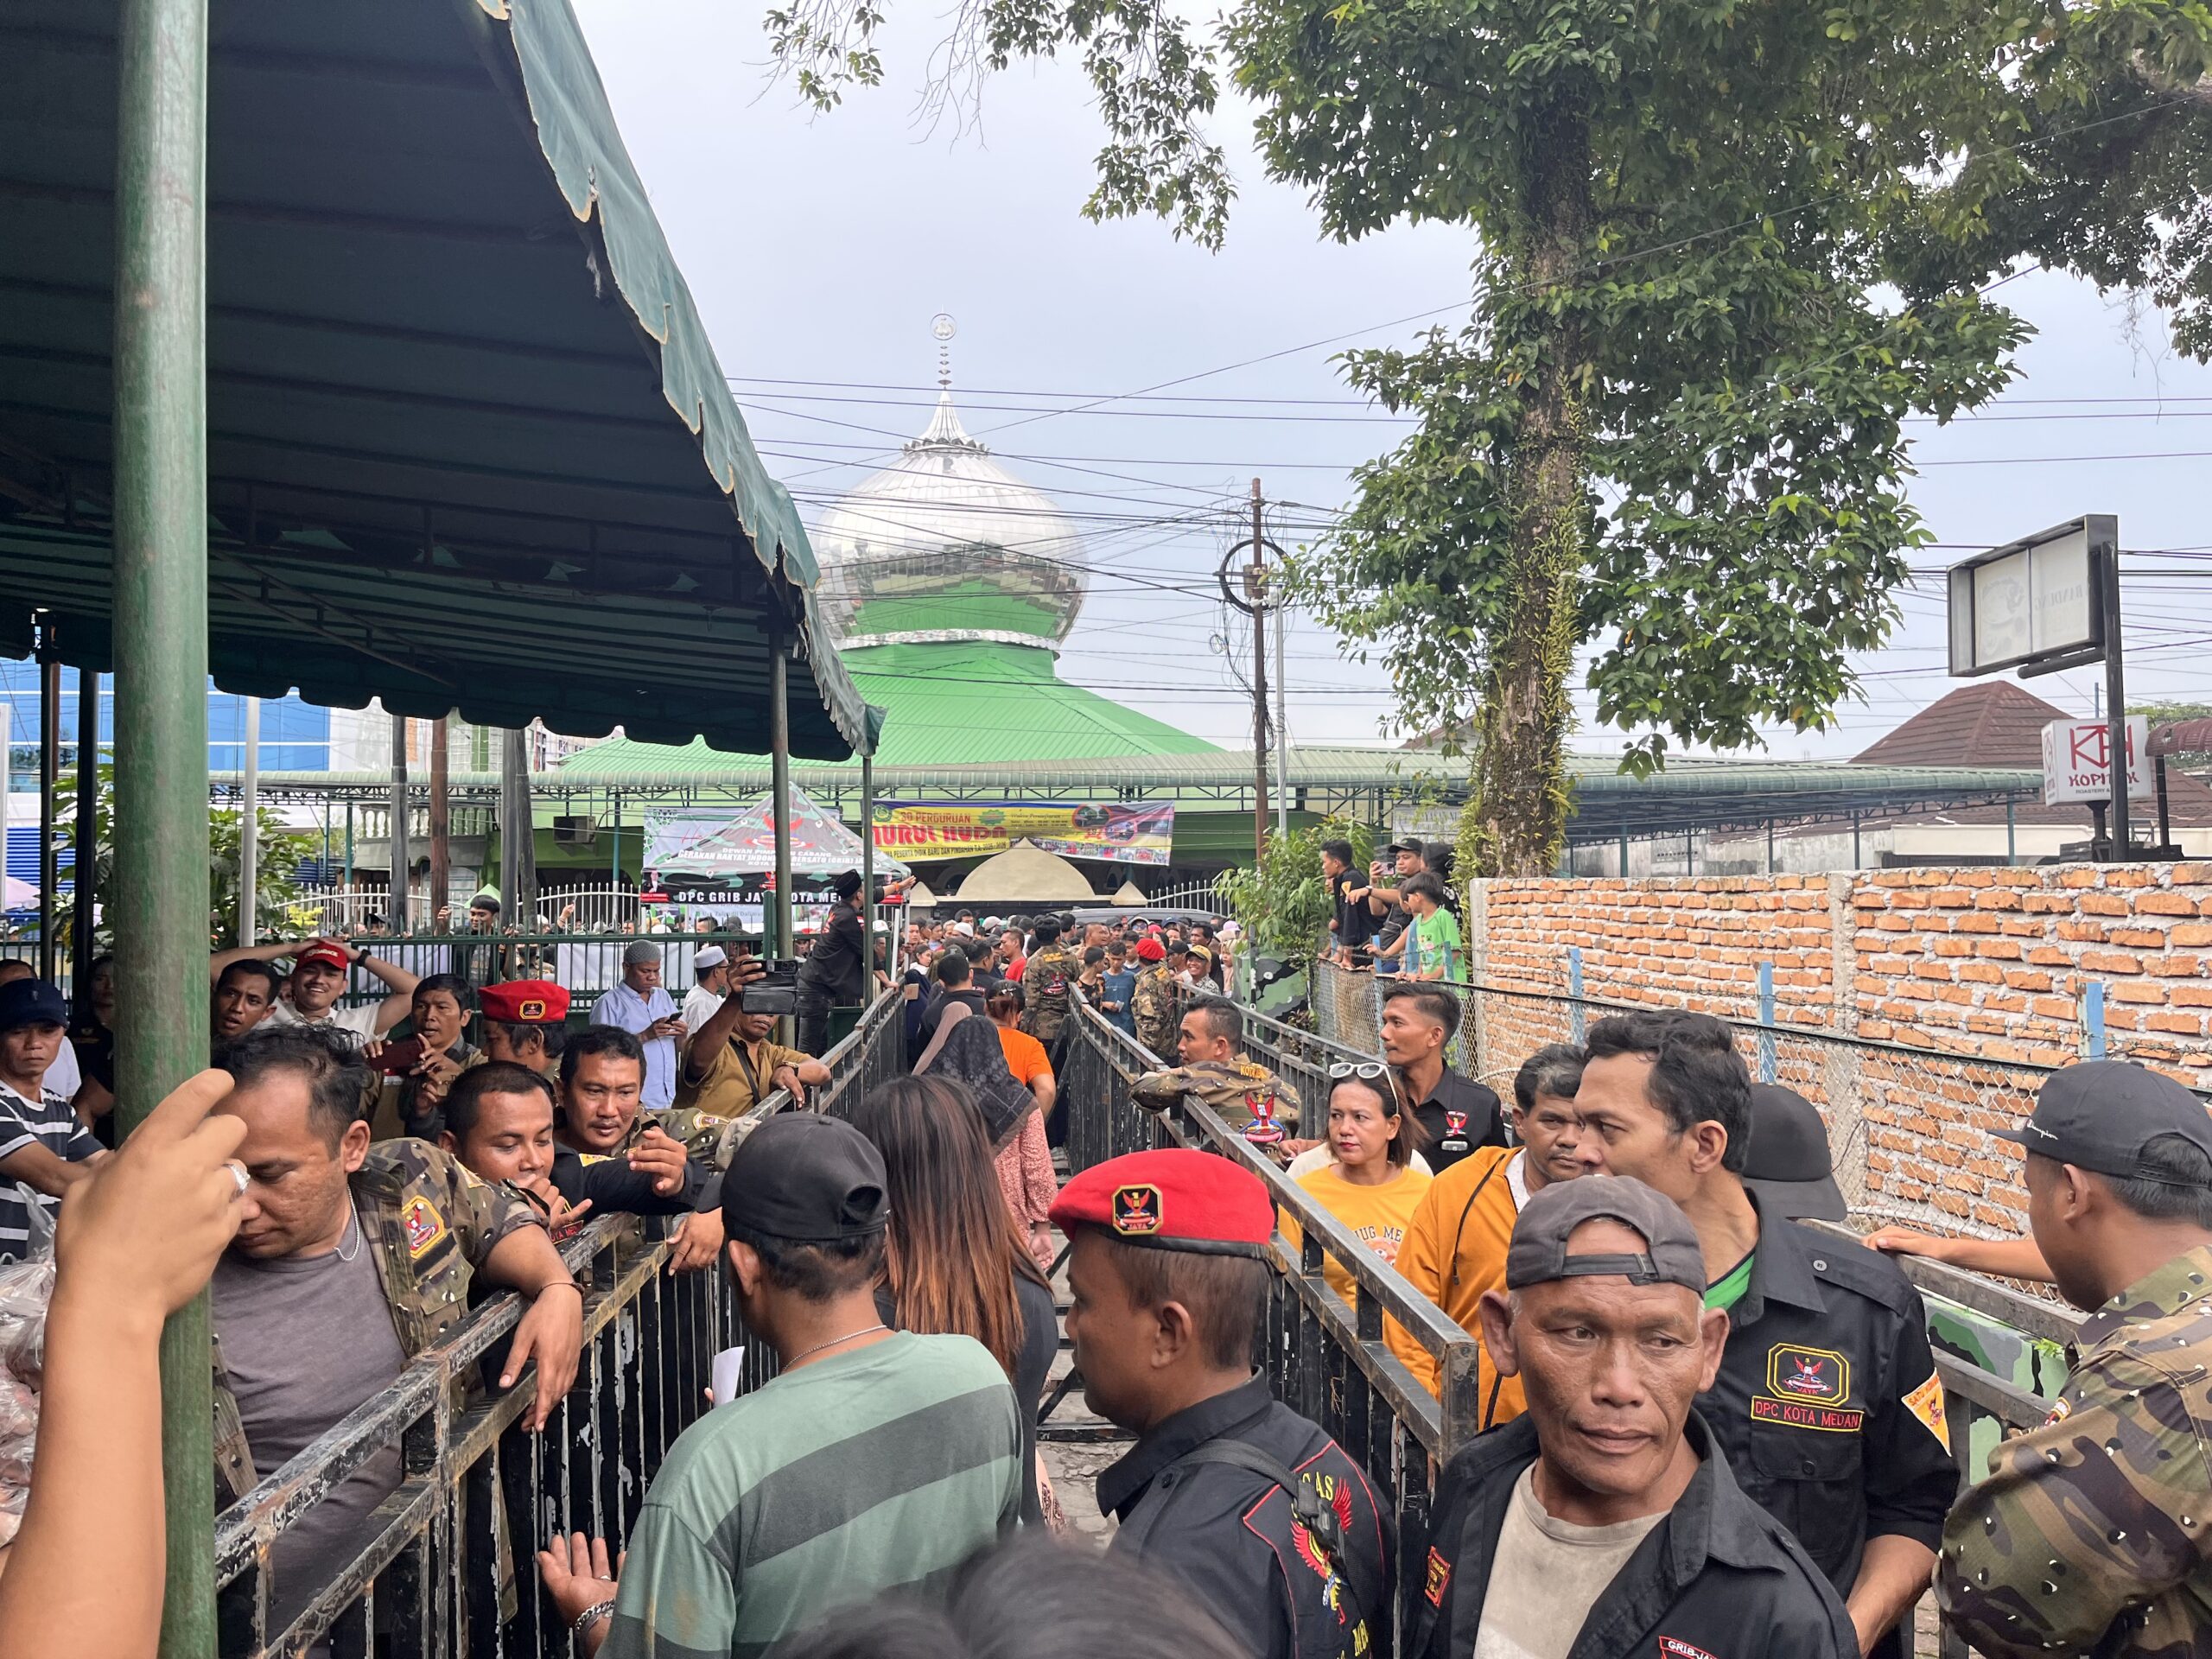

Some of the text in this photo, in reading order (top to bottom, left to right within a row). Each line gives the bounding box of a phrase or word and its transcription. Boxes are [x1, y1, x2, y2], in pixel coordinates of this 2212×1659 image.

[2069, 772, 2140, 787] KOPIK
[916, 812, 971, 823] PERGURUAN
[678, 849, 715, 860] GERAKAN
[716, 853, 747, 861] RAKYAT
[928, 848, 940, 856] BARU
[679, 892, 705, 902] DPC
[709, 892, 741, 903] GRIB
[791, 892, 814, 903] OTA
[1127, 1222, 1148, 1231] JAYA
[1383, 1225, 1403, 1243] ME
[1754, 1400, 1859, 1429] DPC KOTA MEDAN
